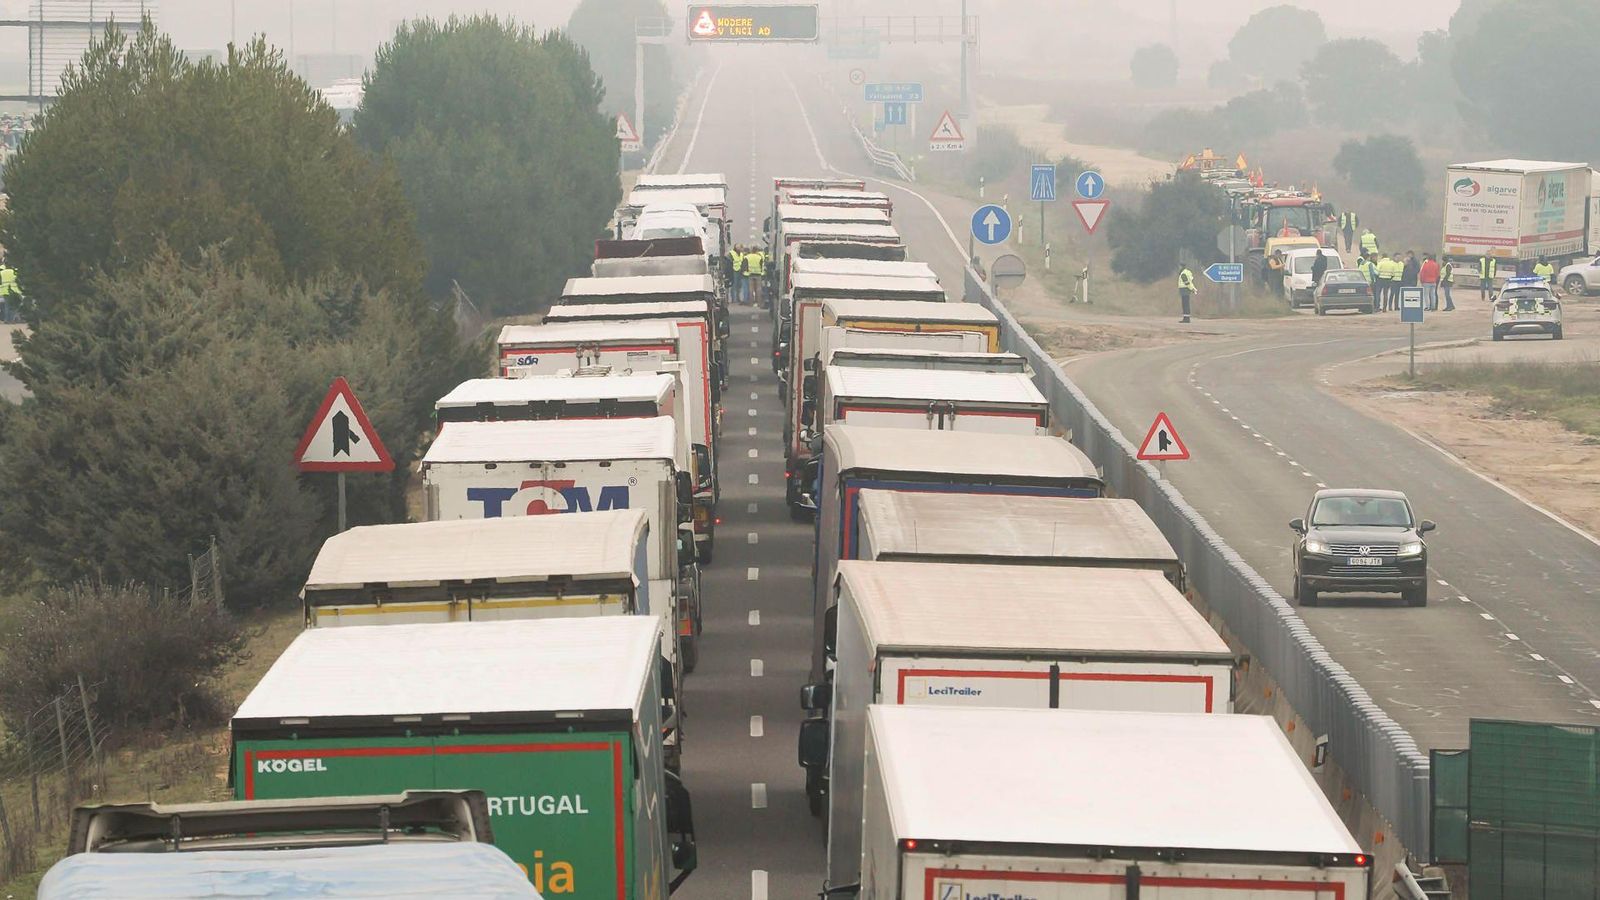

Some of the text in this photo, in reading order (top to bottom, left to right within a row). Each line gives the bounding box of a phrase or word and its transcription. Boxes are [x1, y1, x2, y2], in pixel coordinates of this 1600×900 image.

[1487, 186, 1517, 195] algarve
[928, 686, 982, 696] LeciTrailer
[257, 758, 328, 773] KÖGEL
[487, 794, 589, 816] RTUGAL
